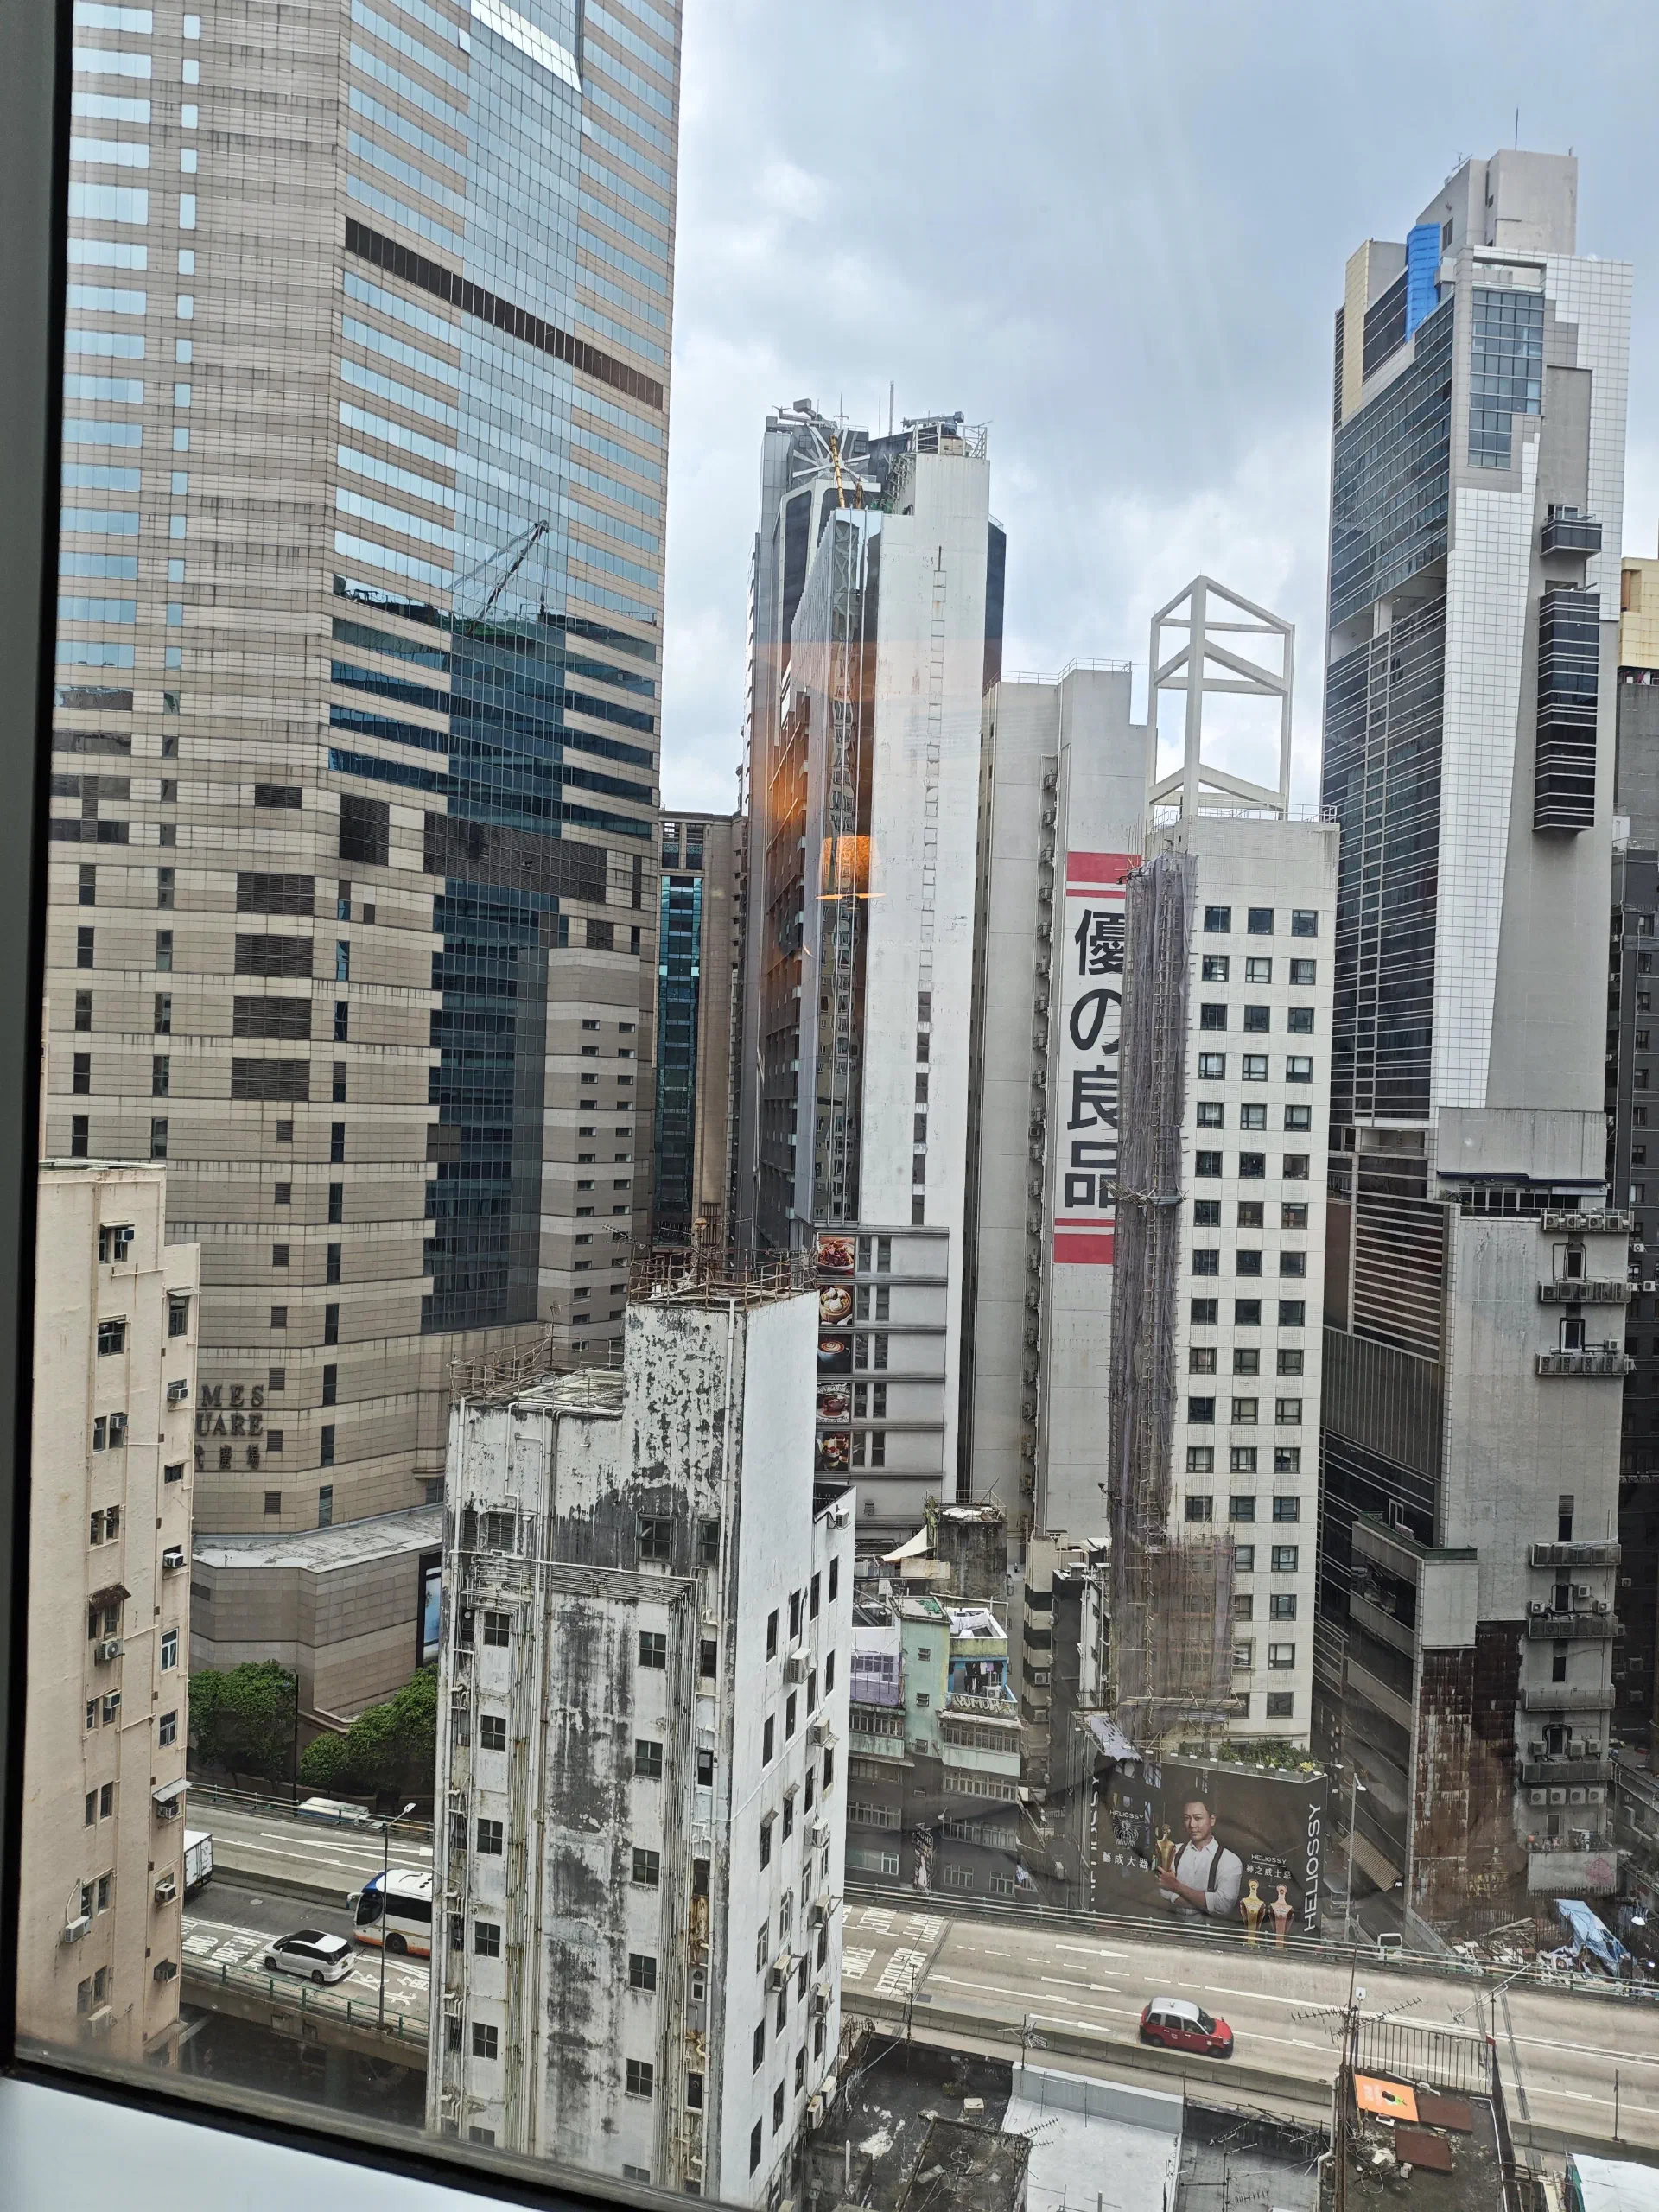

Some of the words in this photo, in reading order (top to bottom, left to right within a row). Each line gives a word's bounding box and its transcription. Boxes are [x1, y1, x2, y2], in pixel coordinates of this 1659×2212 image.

[1109, 1809, 1144, 1821] HELIOSSY
[1102, 1851, 1149, 1869] 藝成大器
[1251, 1853, 1287, 1865] HELIOSSY
[1303, 1803, 1321, 1932] HELIOSSY
[181, 1935, 219, 1955] AND
